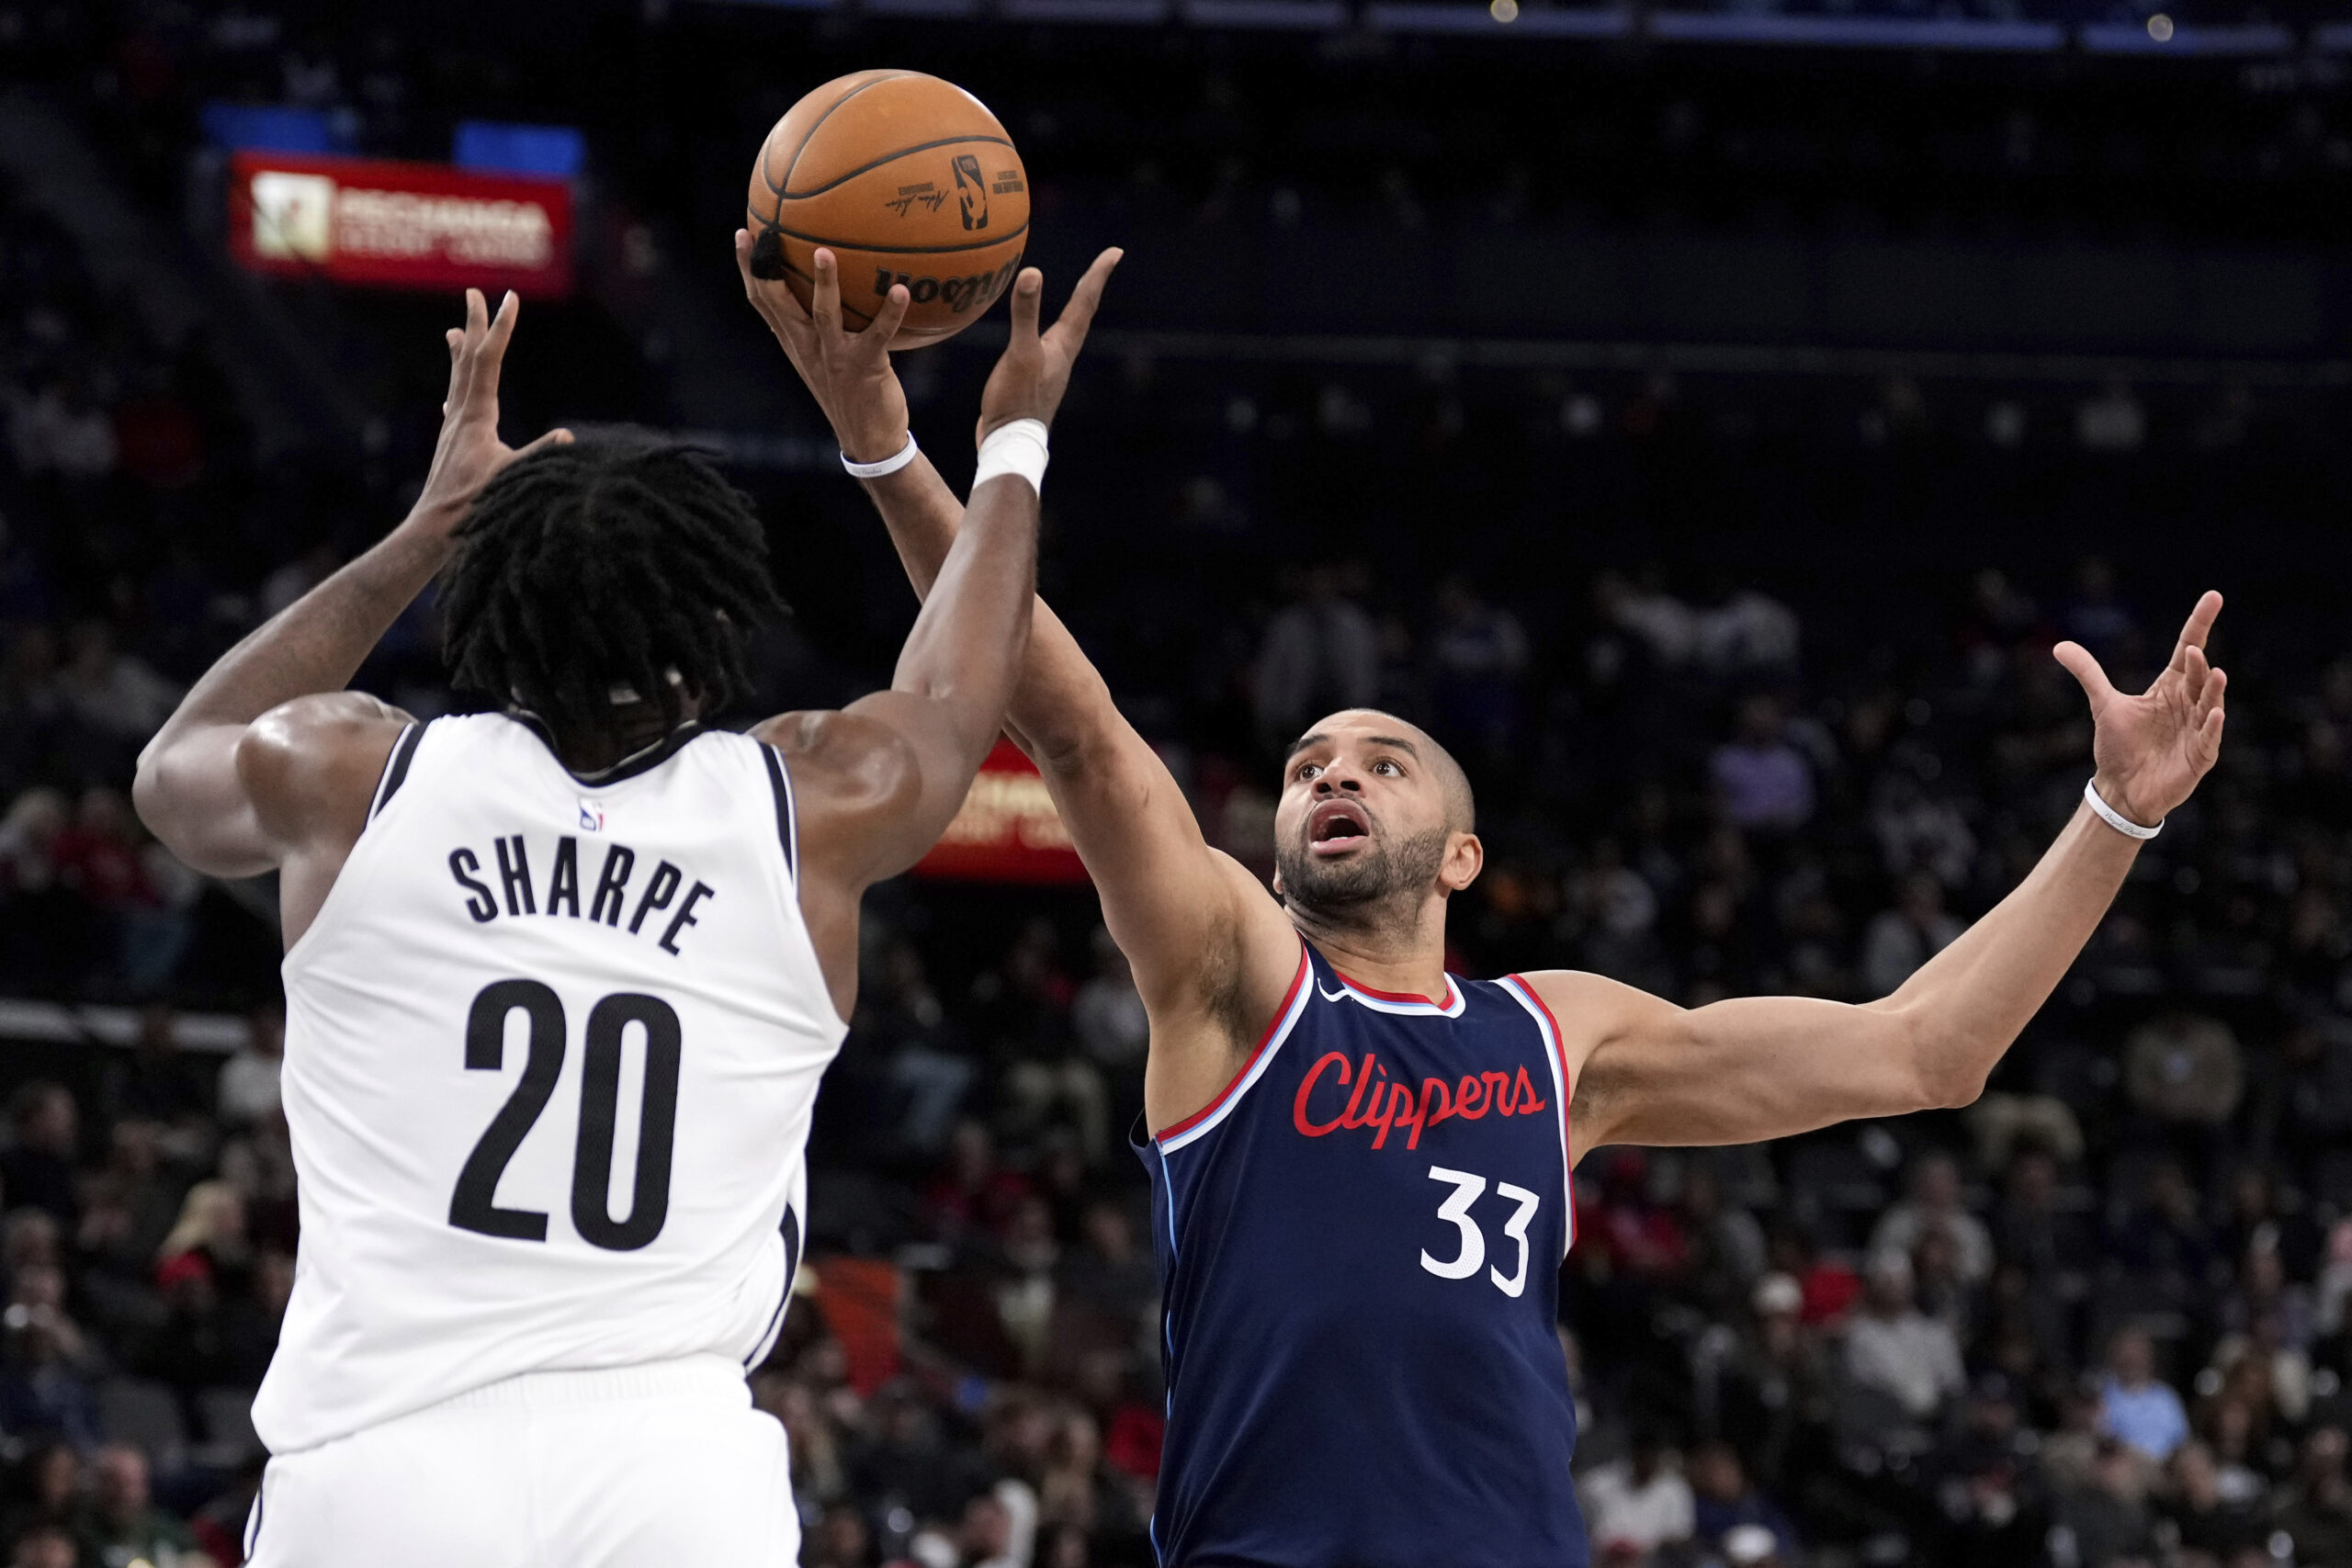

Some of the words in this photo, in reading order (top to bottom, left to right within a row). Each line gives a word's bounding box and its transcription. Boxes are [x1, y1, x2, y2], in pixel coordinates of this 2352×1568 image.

[448, 834, 715, 956] SHARPE
[448, 977, 683, 1252] 20
[1293, 1051, 1546, 1150] Clippers
[1420, 1165, 1541, 1298] 33
